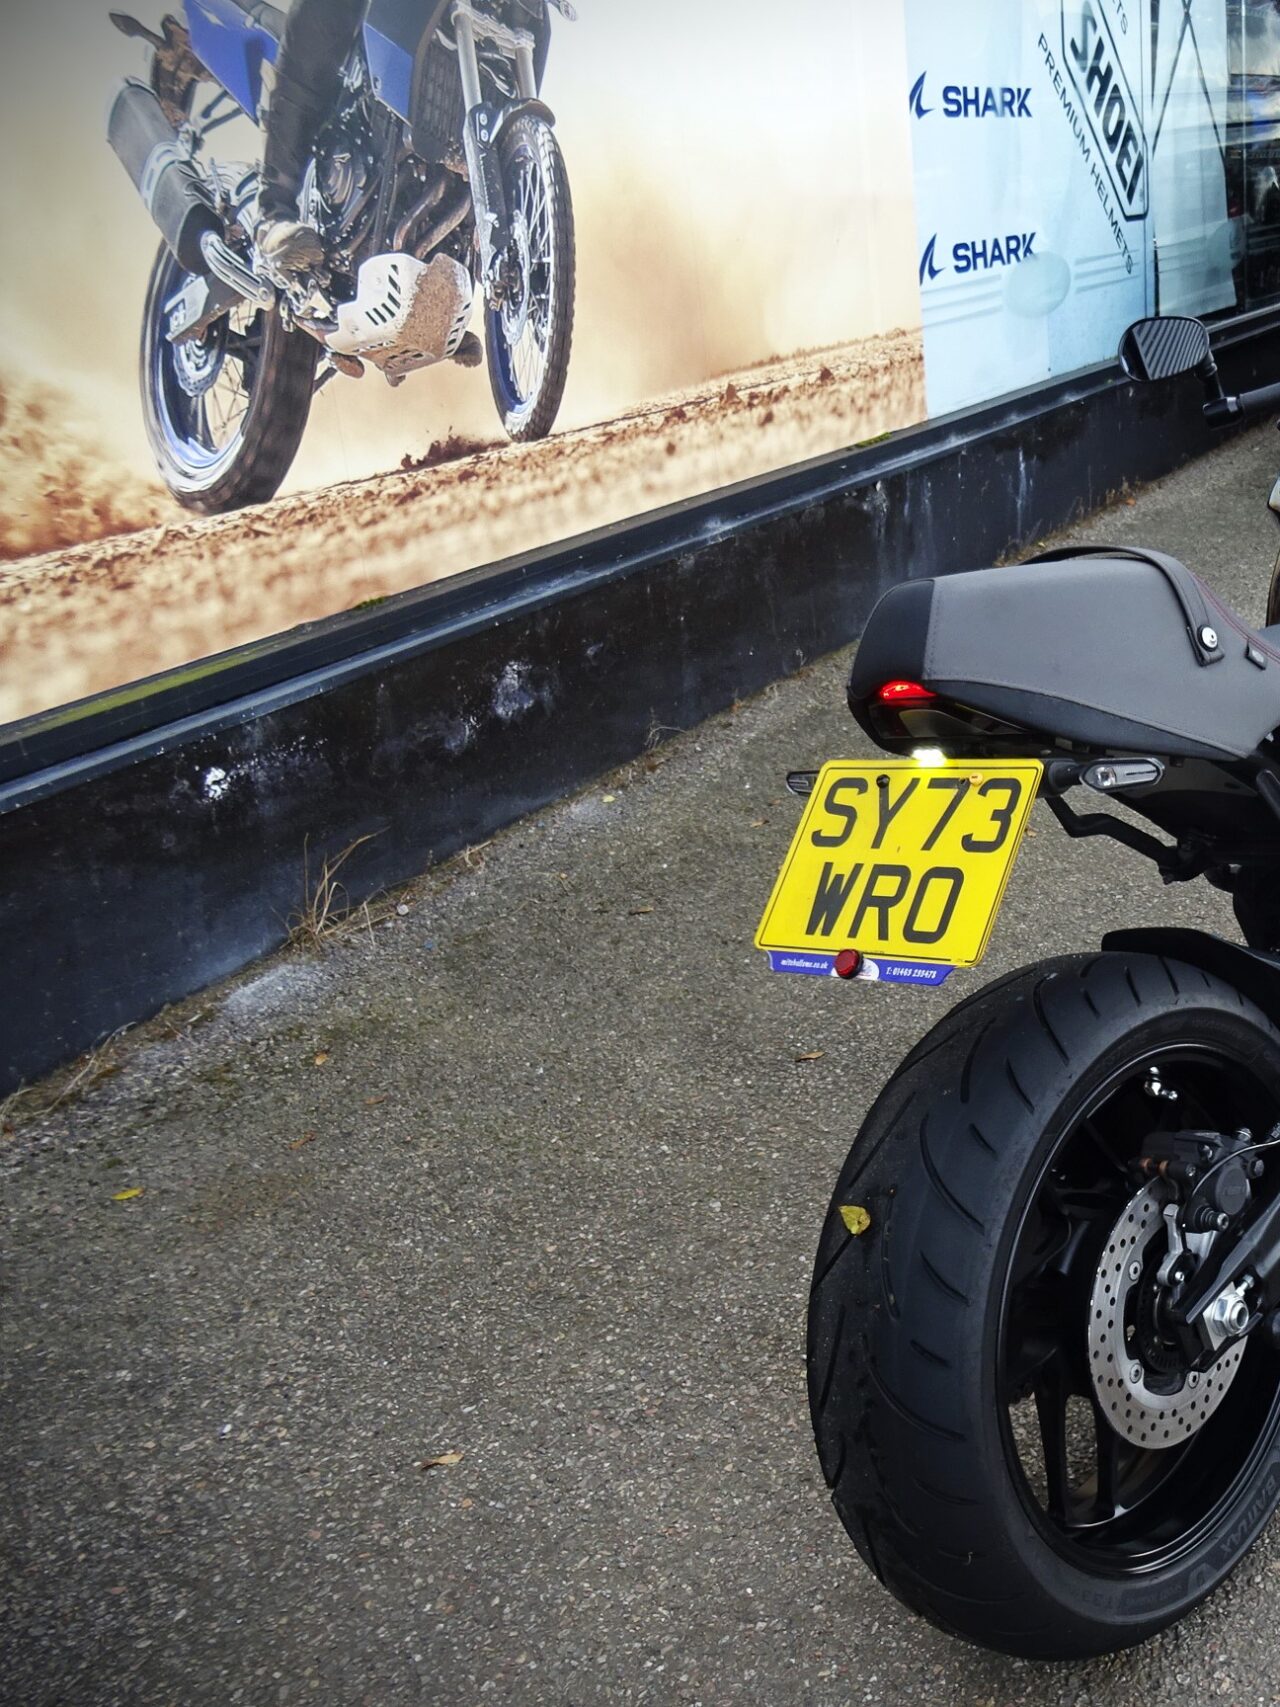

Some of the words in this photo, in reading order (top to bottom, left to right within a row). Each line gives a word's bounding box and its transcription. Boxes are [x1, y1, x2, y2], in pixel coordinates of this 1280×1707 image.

[942, 85, 1033, 118] SHARK
[1070, 0, 1144, 206] SHOEI
[1038, 32, 1091, 164] PREMIUM
[1090, 163, 1134, 275] HELMETS
[953, 232, 1037, 274] SHARK
[811, 777, 1022, 853] SY73
[805, 862, 965, 944] WRO
